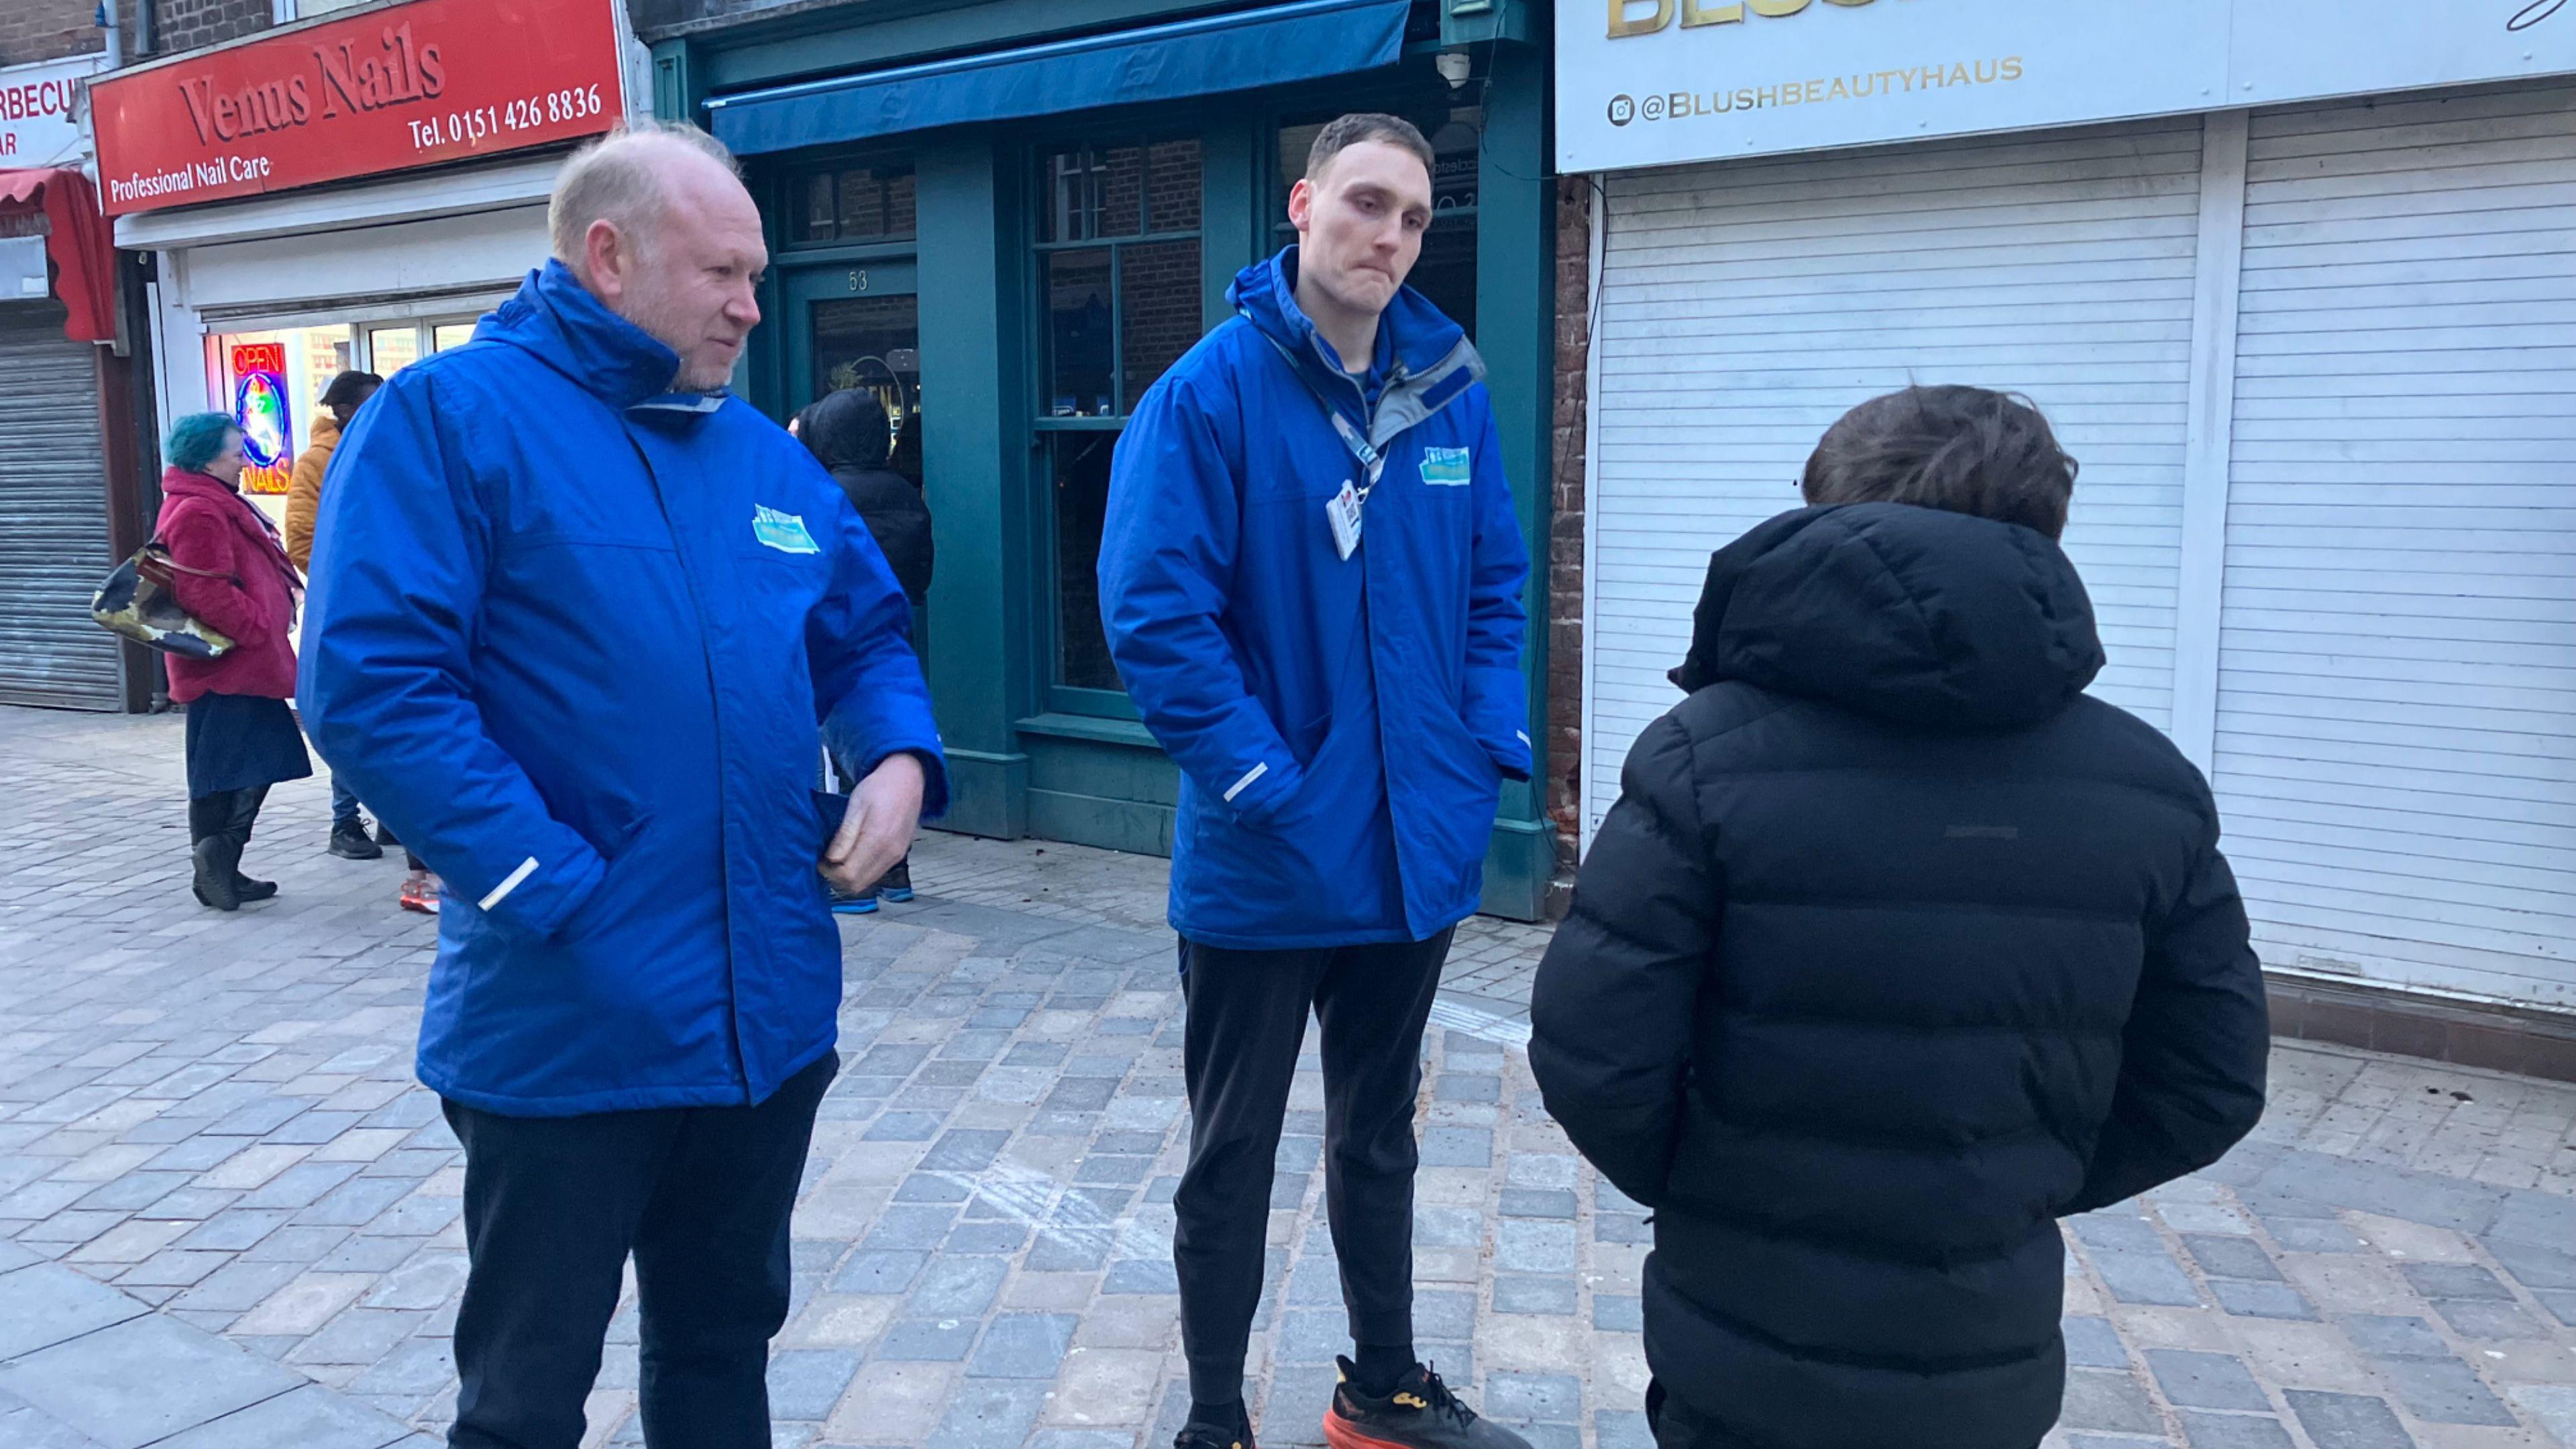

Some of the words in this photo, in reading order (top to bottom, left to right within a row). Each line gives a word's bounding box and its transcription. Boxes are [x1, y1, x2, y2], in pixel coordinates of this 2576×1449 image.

[178, 74, 311, 147] Venus
[313, 20, 445, 119] Nails
[1641, 54, 2023, 121] @BLUSHBEAUTYHAUS
[408, 116, 445, 149] Tel.
[449, 105, 498, 140] 0151
[504, 96, 541, 131] 426
[547, 83, 602, 123] 8836
[111, 162, 193, 203] Professional
[196, 156, 227, 188] Nail
[229, 155, 270, 182] Care
[234, 345, 280, 375] OPEN
[242, 458, 290, 492] NAILS
